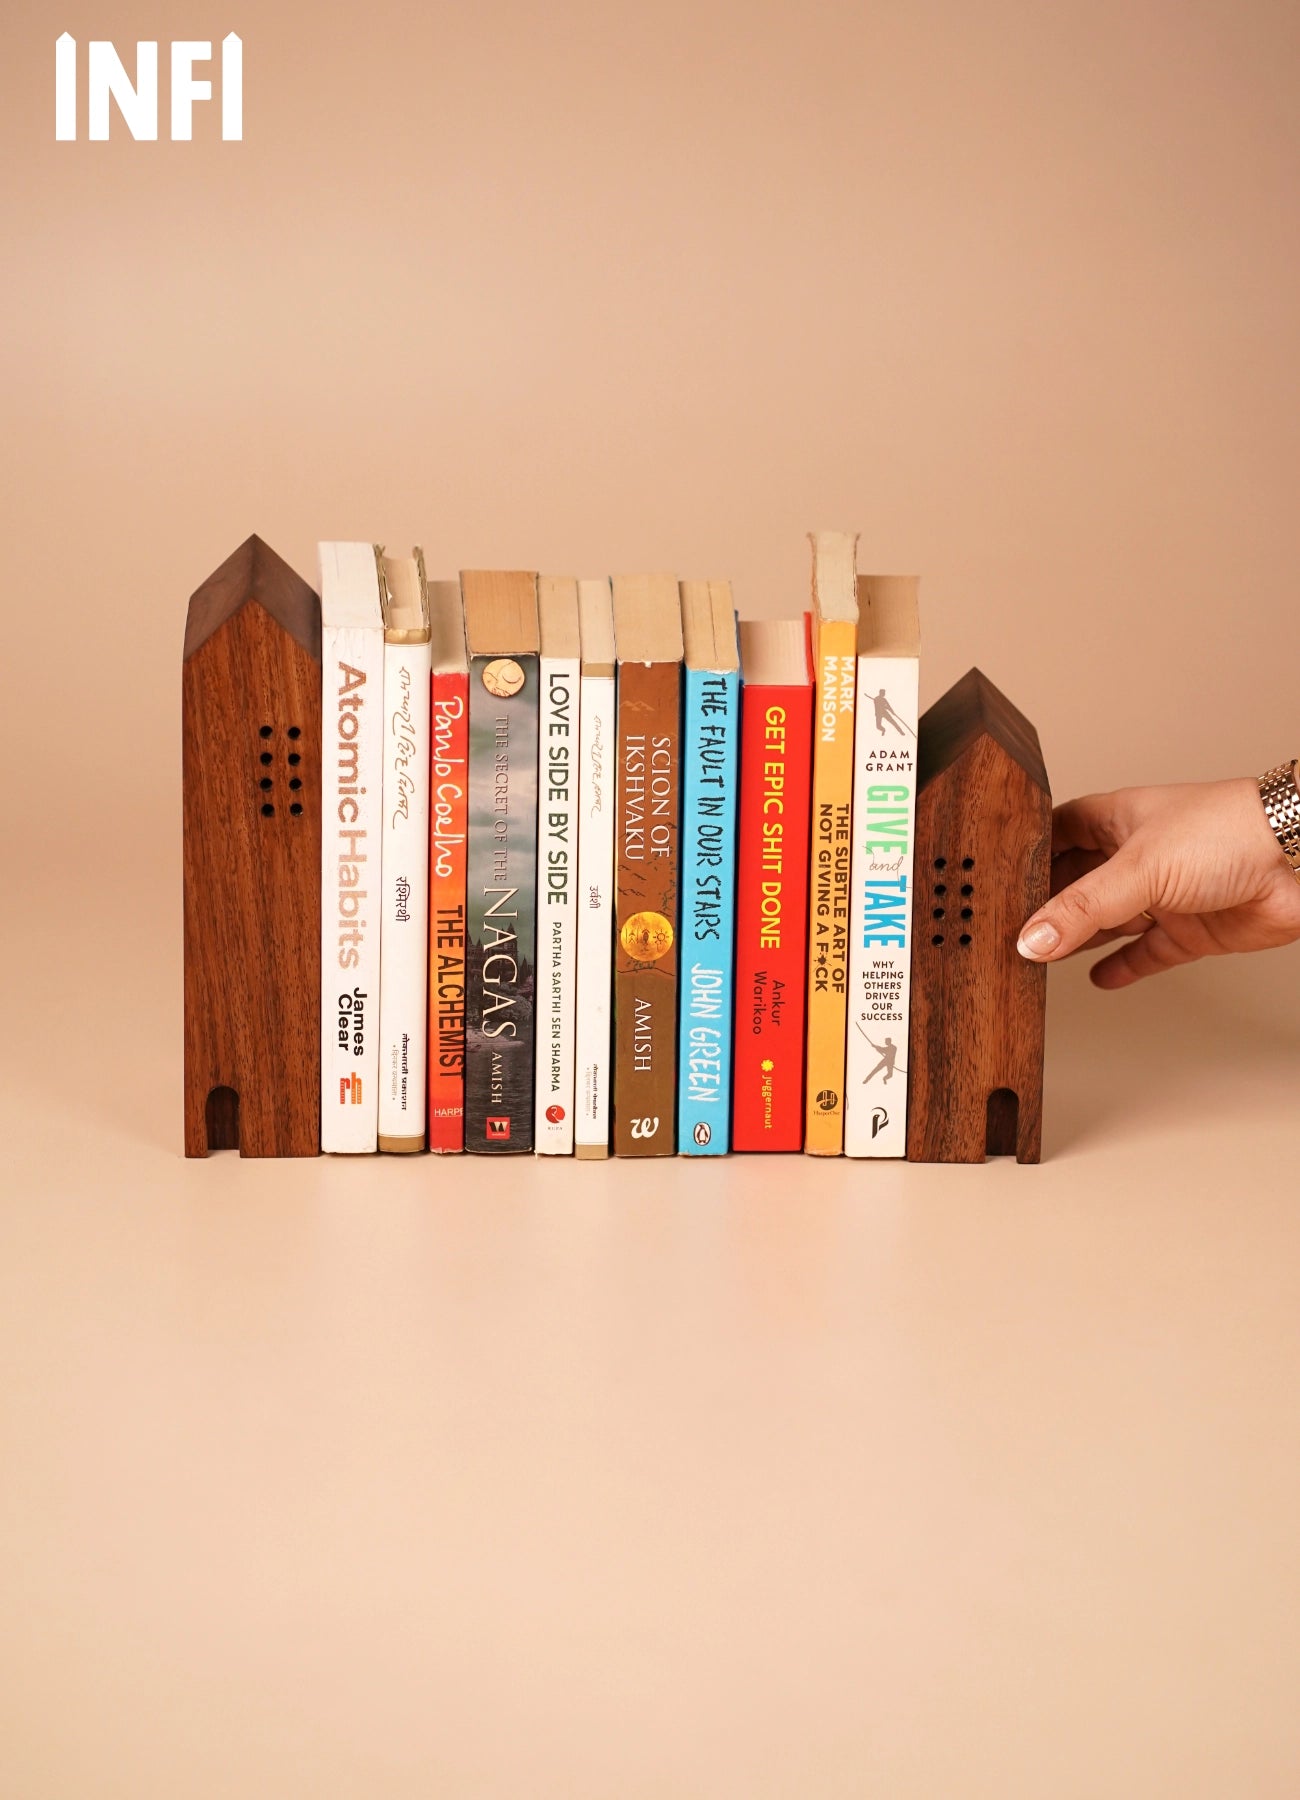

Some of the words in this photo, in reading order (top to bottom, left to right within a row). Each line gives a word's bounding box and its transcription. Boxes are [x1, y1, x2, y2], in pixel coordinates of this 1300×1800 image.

[549, 674, 570, 737] LOVE
[701, 677, 728, 716] THE
[821, 656, 838, 742] MANSON
[839, 656, 856, 713] MARK
[337, 661, 367, 823] Atomic
[434, 696, 464, 777] Paulo
[495, 715, 509, 748] THE
[765, 706, 786, 754] GET
[869, 750, 910, 759] ADAM
[548, 746, 569, 802] SIDE
[651, 737, 671, 816] SCION
[698, 725, 726, 788] FAULT
[865, 763, 913, 772] GRANT
[495, 754, 509, 815] SECRET
[625, 735, 645, 860] IKSHVAKU
[697, 796, 726, 817] IN
[763, 762, 785, 815] EPIC
[433, 783, 466, 878] Coelho
[494, 820, 508, 843] OF
[548, 813, 568, 843] BY
[650, 825, 670, 858] OF
[696, 824, 723, 867] OUR
[819, 803, 833, 844] NOT
[835, 803, 850, 840] THE
[865, 785, 910, 855] GIVE
[494, 850, 508, 882] THE
[761, 823, 784, 874] SHIT
[868, 856, 903, 872] and
[338, 829, 367, 970] Habits
[395, 876, 410, 922] रश्मिरथी
[547, 850, 568, 905] SIDE
[589, 885, 601, 909] उर्वशी
[816, 849, 831, 917] GIVING
[833, 846, 849, 919] SUBTLE
[437, 905, 463, 948] THE
[693, 874, 721, 940] STARS
[760, 881, 782, 949] DONE
[816, 922, 829, 935] A
[864, 875, 907, 948] TAKE
[482, 886, 519, 1038] NAGAS
[551, 922, 562, 968] PARTHA
[815, 942, 829, 992] FCK
[833, 924, 846, 962] ART
[551, 970, 562, 1013] SARTHI
[689, 962, 724, 1019] JOHN
[832, 967, 845, 994] OF
[862, 971, 904, 979] HELPING
[864, 982, 902, 990] OTHERS
[865, 992, 900, 1000] DRIVES
[338, 993, 353, 1051] Clear
[353, 987, 367, 1056] James
[437, 954, 465, 1081] ALCHEMIST
[551, 1017, 561, 1039] SEN
[752, 971, 767, 1035] Warikoo
[772, 980, 785, 1026] Ankur
[861, 1013, 903, 1021] SUCCESS
[634, 998, 651, 1071] AMISH
[491, 1051, 502, 1104] AMISH
[551, 1043, 561, 1092] SHARMA
[688, 1027, 722, 1102] GREEN
[761, 1075, 773, 1129] juggernaut
